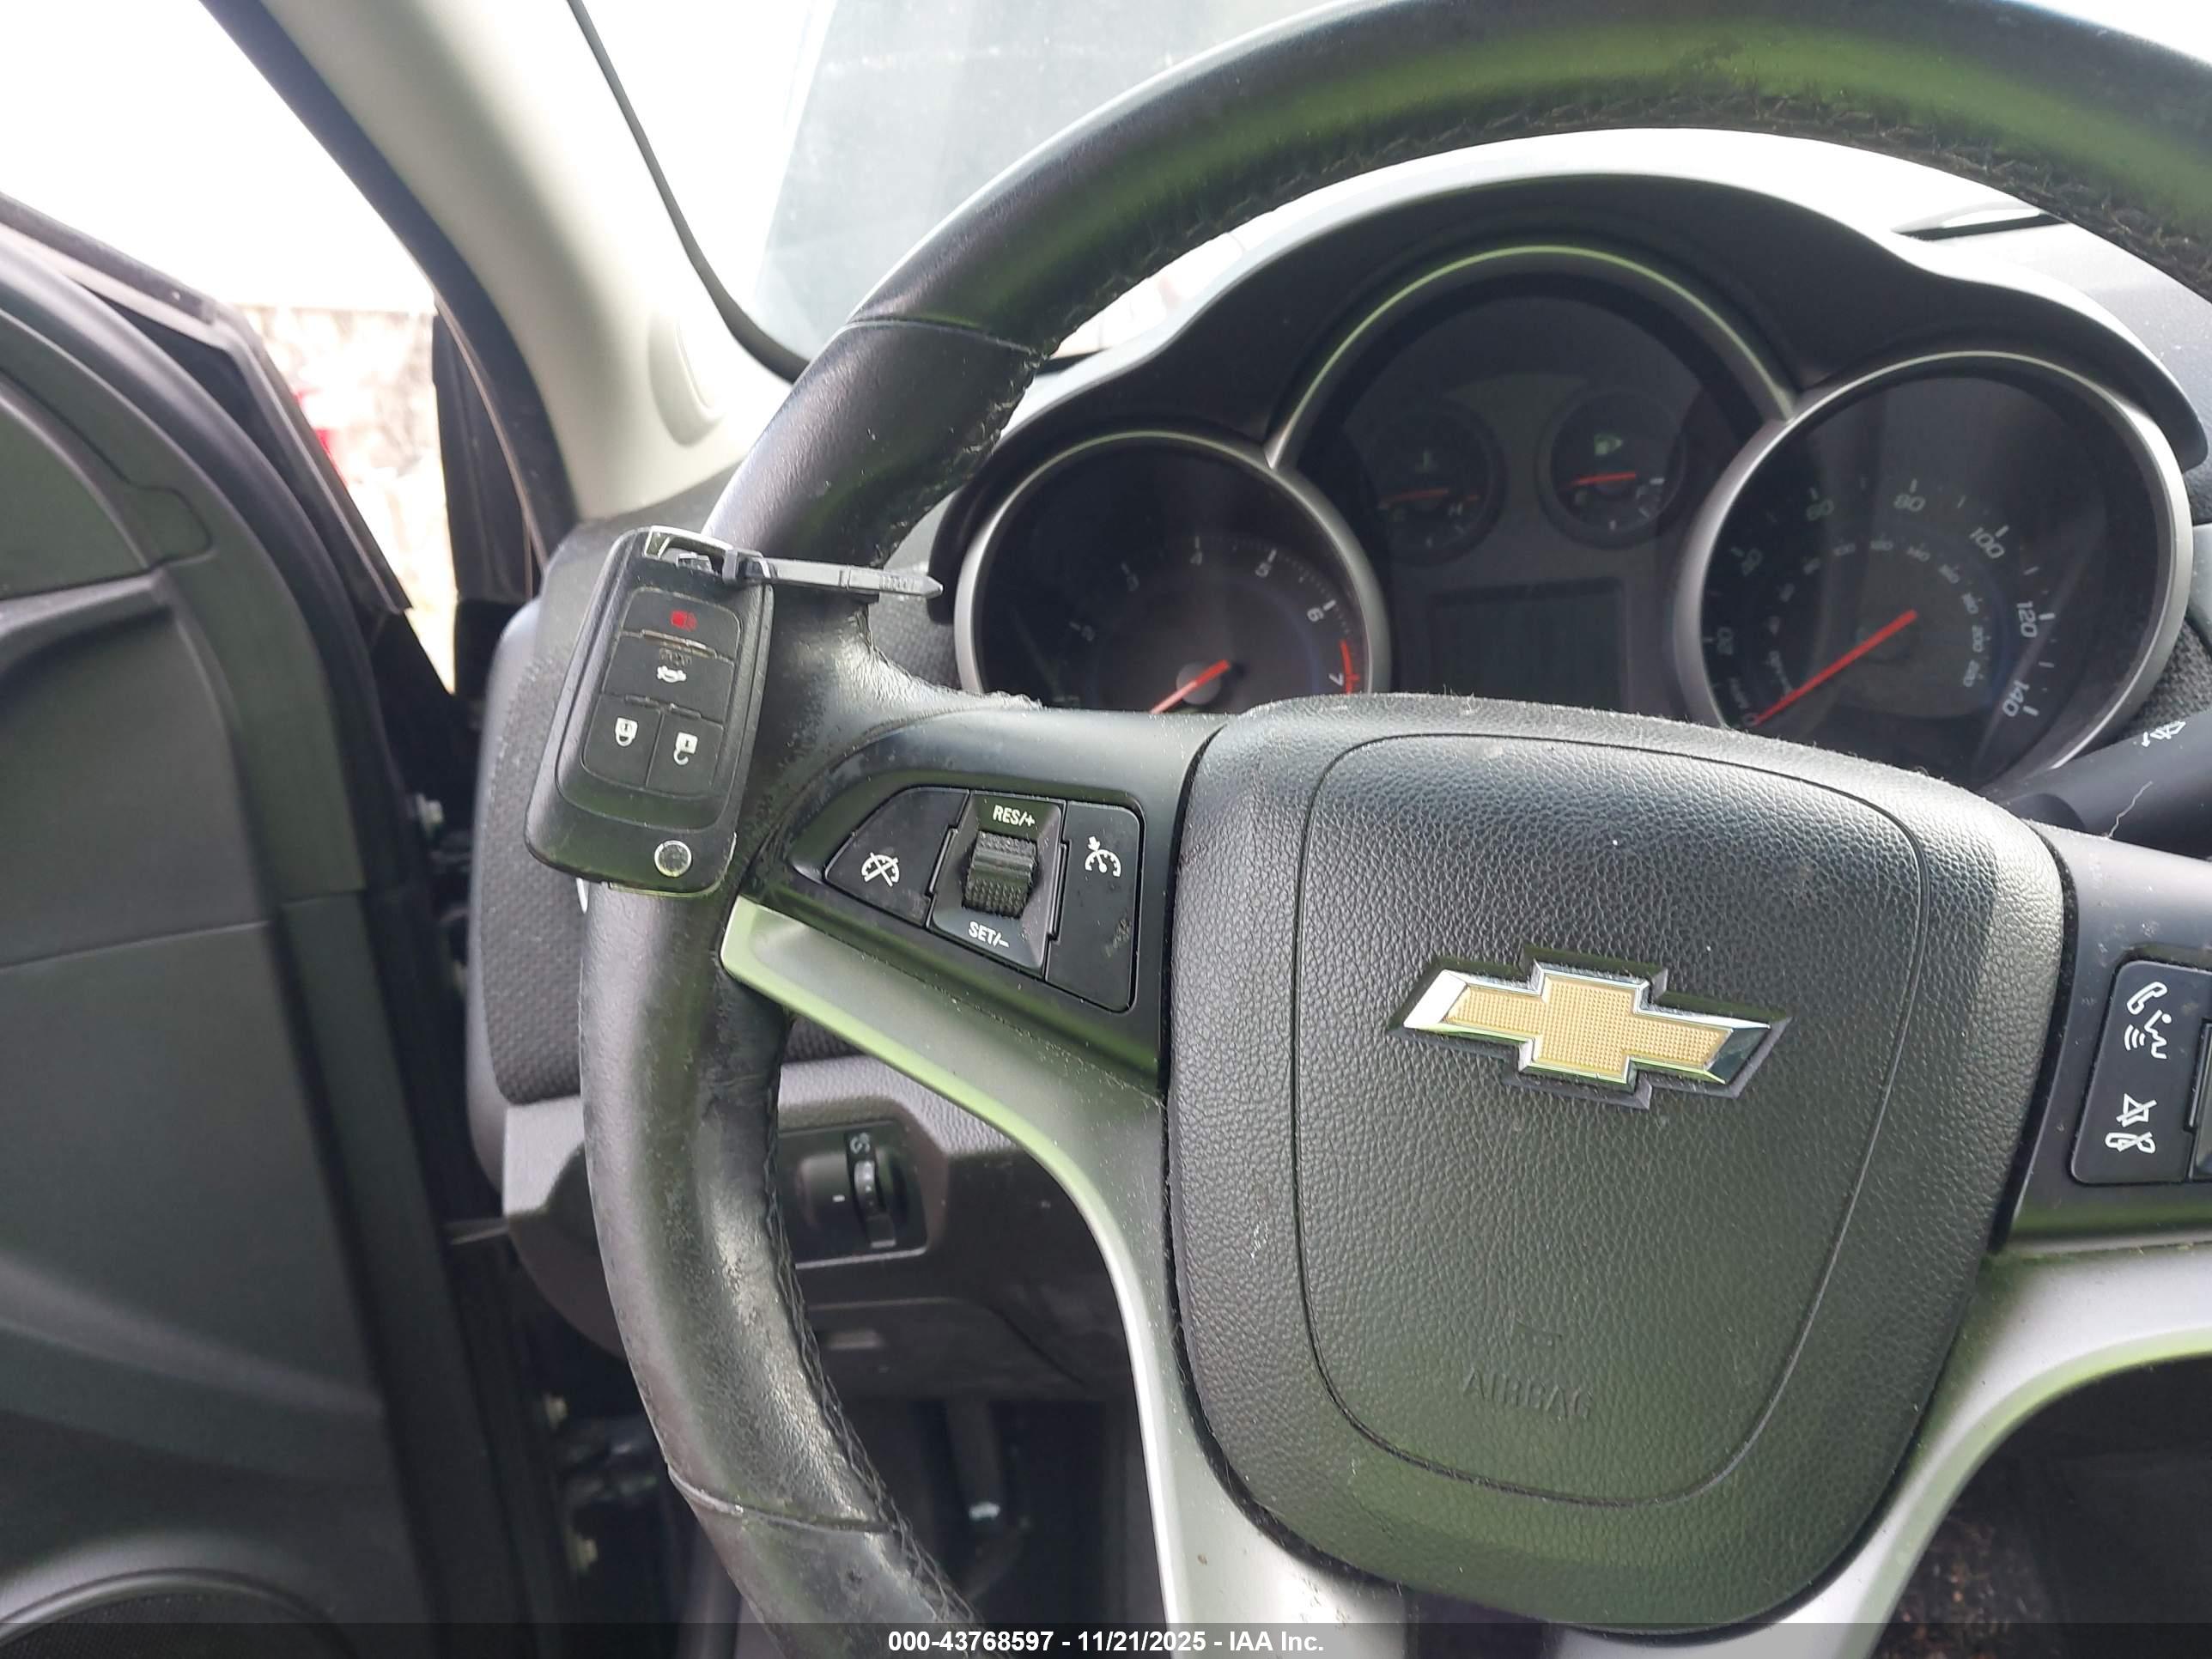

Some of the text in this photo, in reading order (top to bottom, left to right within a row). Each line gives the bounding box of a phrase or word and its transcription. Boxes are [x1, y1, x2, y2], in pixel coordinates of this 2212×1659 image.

[1893, 493, 1927, 513] 80
[1969, 526, 2006, 560] 100
[1305, 605, 1325, 623] 6
[2015, 601, 2039, 639] 120
[1328, 672, 1345, 687] 7
[2002, 679, 2031, 719] 140
[992, 804, 1036, 827] RES/+
[968, 920, 1011, 949] SET/-
[1462, 1366, 1594, 1421] AIRBAG
